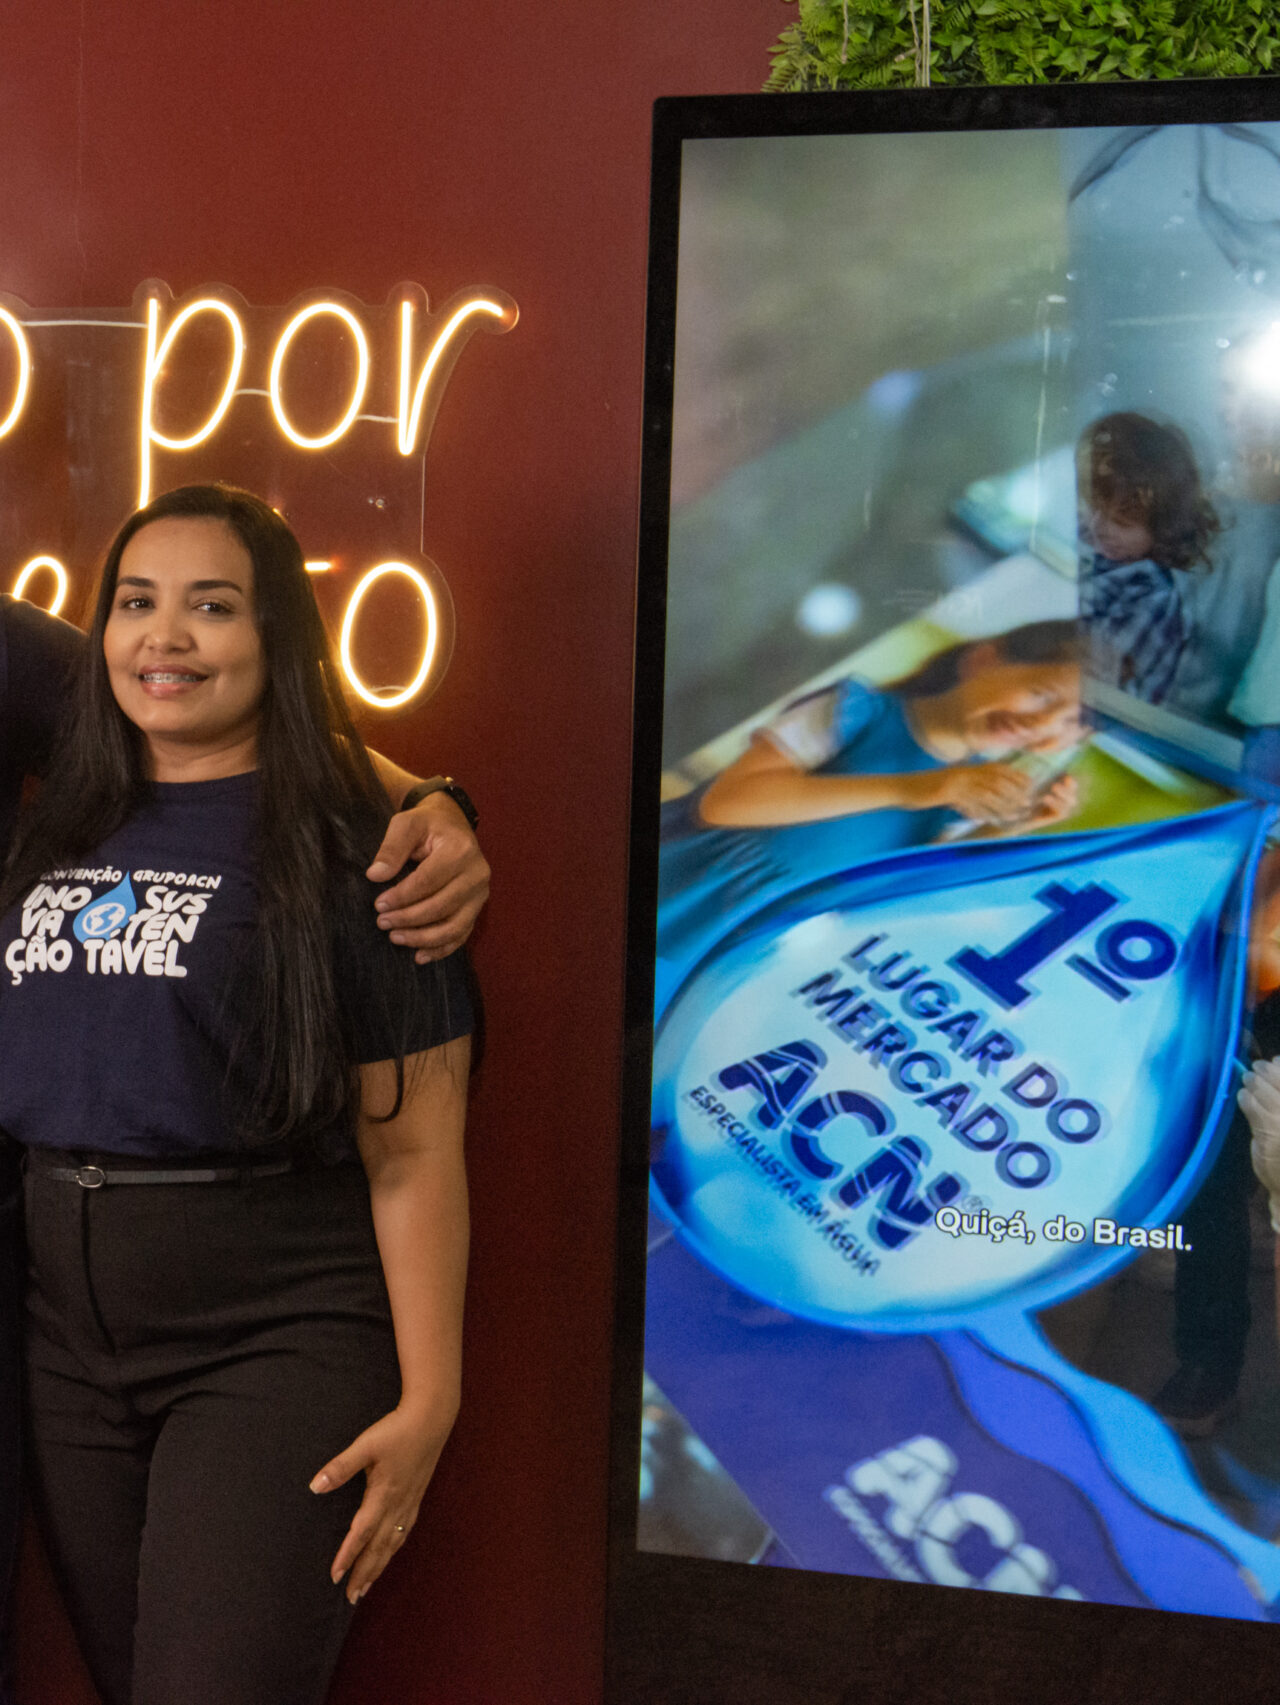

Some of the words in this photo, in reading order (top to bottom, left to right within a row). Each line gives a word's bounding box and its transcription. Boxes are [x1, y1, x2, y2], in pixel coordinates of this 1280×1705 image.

[139, 297, 505, 510] por
[22, 883, 92, 911] INO
[145, 885, 213, 915] SUS
[21, 908, 64, 937] VA
[125, 908, 200, 943] TEN
[946, 880, 1182, 1011] 1º
[5, 936, 73, 986] ÇÃO
[83, 928, 188, 978] TÁVEL
[841, 931, 1026, 1078] LUGAR
[1001, 1060, 1110, 1149] DO
[789, 966, 1061, 1190] MERCADO
[710, 1038, 970, 1252] ACN
[688, 1085, 803, 1200] ESPECIALISTA
[790, 1191, 831, 1226] EM
[817, 1217, 882, 1278] ÁGUA
[935, 1206, 1035, 1244] Quiçá,
[1043, 1214, 1086, 1243] do
[1093, 1223, 1193, 1252] Brasil.
